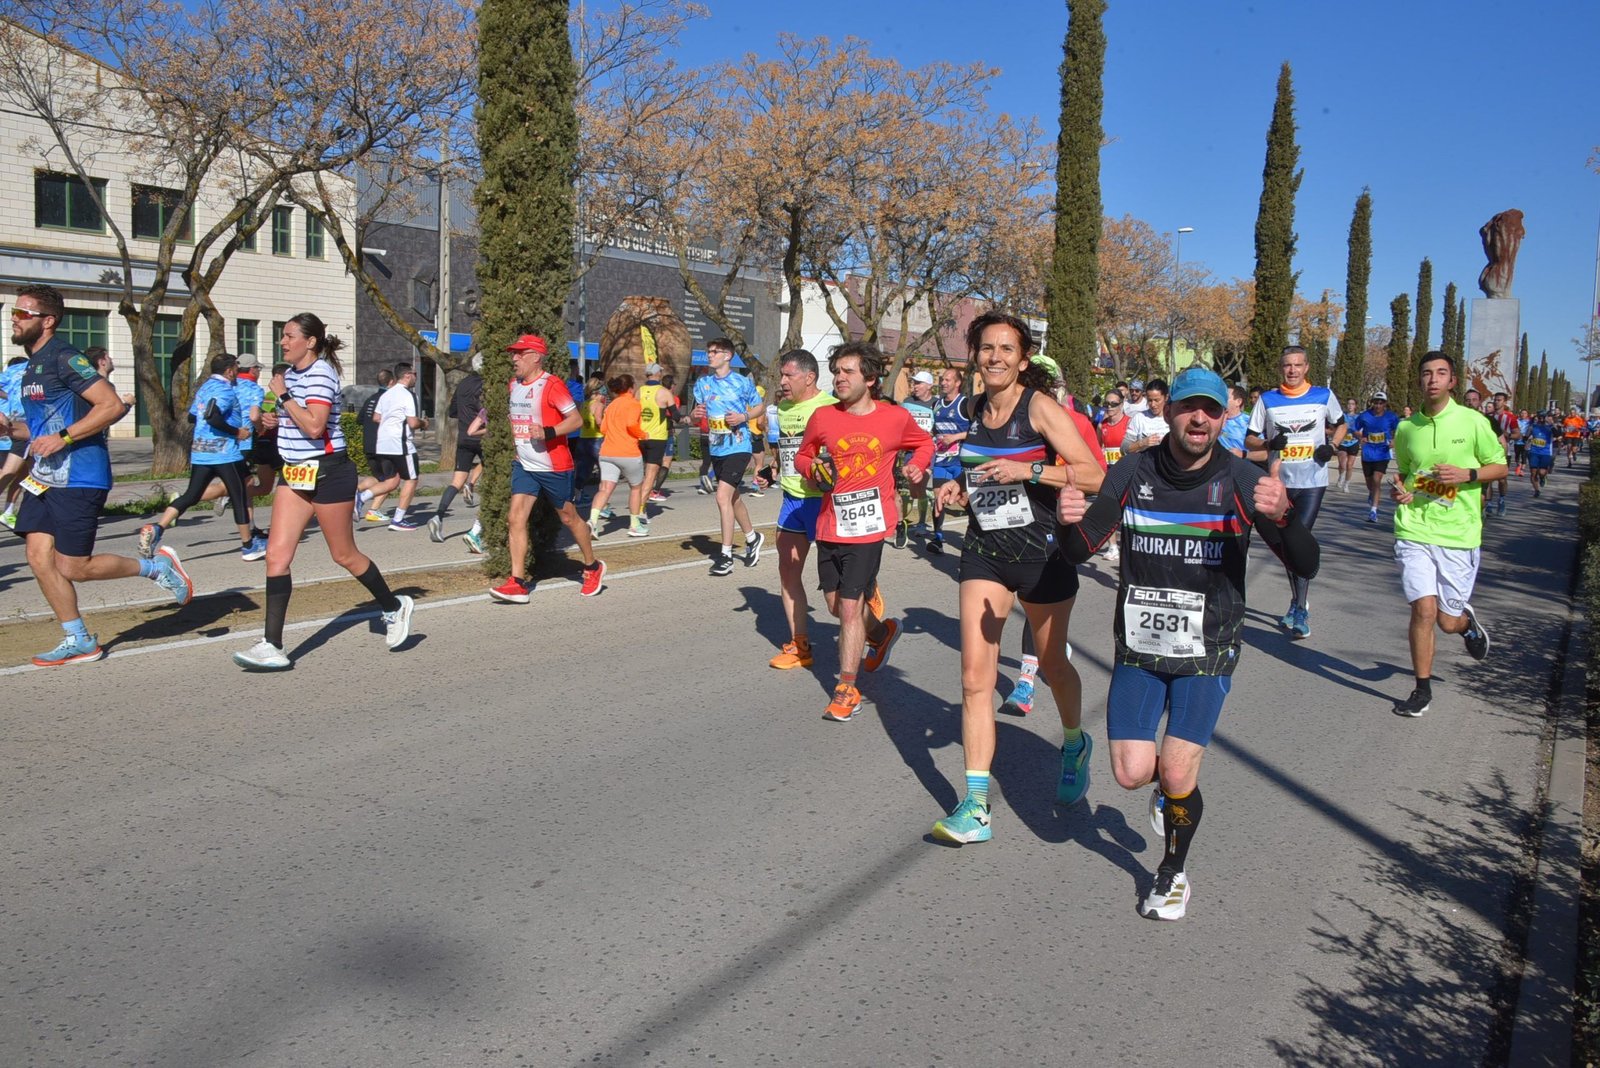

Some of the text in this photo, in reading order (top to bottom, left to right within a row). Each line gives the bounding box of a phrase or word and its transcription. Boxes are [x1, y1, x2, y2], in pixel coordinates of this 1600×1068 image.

[1282, 446, 1313, 458] 5877
[284, 466, 315, 481] 5991
[834, 489, 875, 503] SOLISS
[1415, 477, 1456, 499] 5800
[841, 503, 876, 521] 2649
[1136, 535, 1182, 557] RURAL
[1184, 539, 1225, 559] PARK
[1133, 589, 1199, 605] SOLISS
[1139, 611, 1190, 633] 2631
